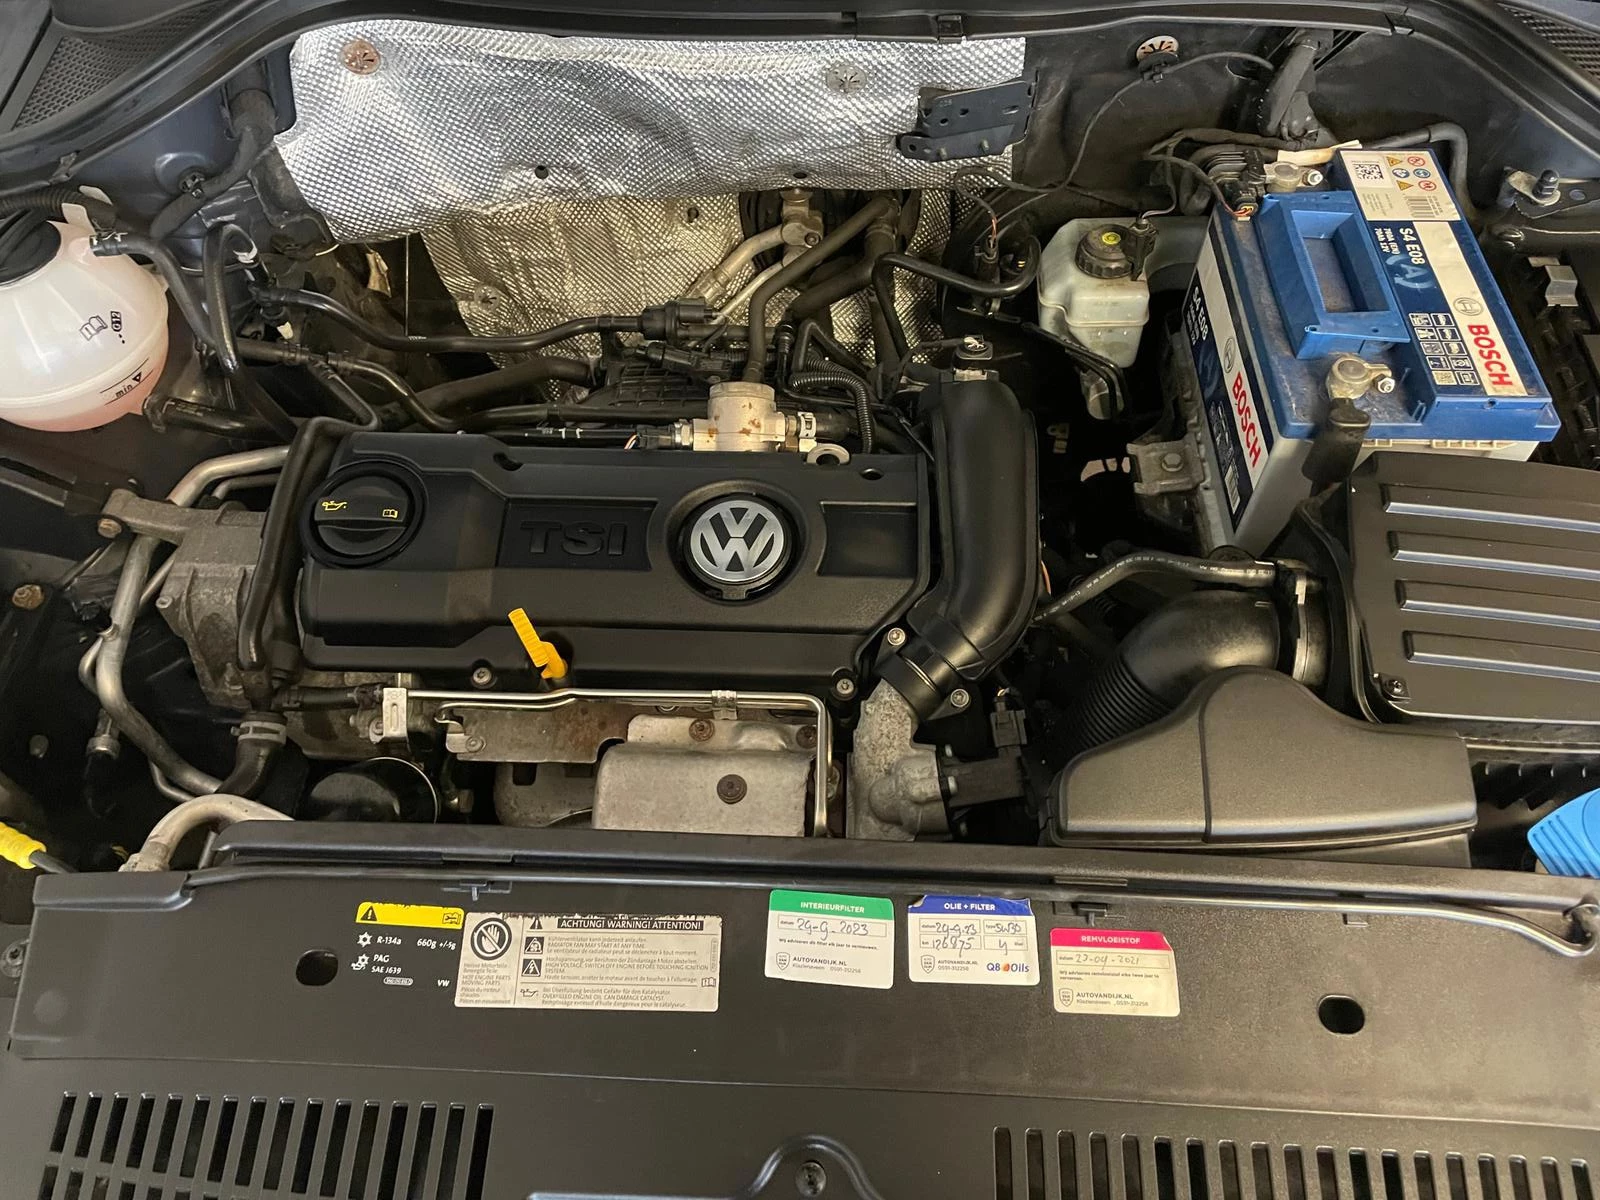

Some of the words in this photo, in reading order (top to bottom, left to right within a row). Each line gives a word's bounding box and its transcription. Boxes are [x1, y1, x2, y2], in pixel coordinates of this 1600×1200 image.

[1400, 228, 1416, 242] S4
[1406, 244, 1426, 265] E08
[1468, 324, 1513, 386] BOSCH
[115, 384, 133, 398] min
[1232, 372, 1262, 468] BOSCH
[520, 520, 628, 555] TSI
[690, 500, 784, 582] VW
[800, 902, 865, 913] INTERIEURFILTER
[561, 920, 604, 928] ACHTUNG!
[607, 920, 650, 929] WARNING!
[652, 921, 700, 929] ATTENTION!
[377, 936, 402, 945] R-134a
[417, 939, 437, 949] 660g
[1081, 935, 1140, 944] REMVLOEISTOF
[373, 954, 389, 962] PAG
[793, 956, 847, 966] AUTOVANDIJK.NL
[987, 963, 1000, 972] Q8
[1011, 963, 1030, 972] Oils
